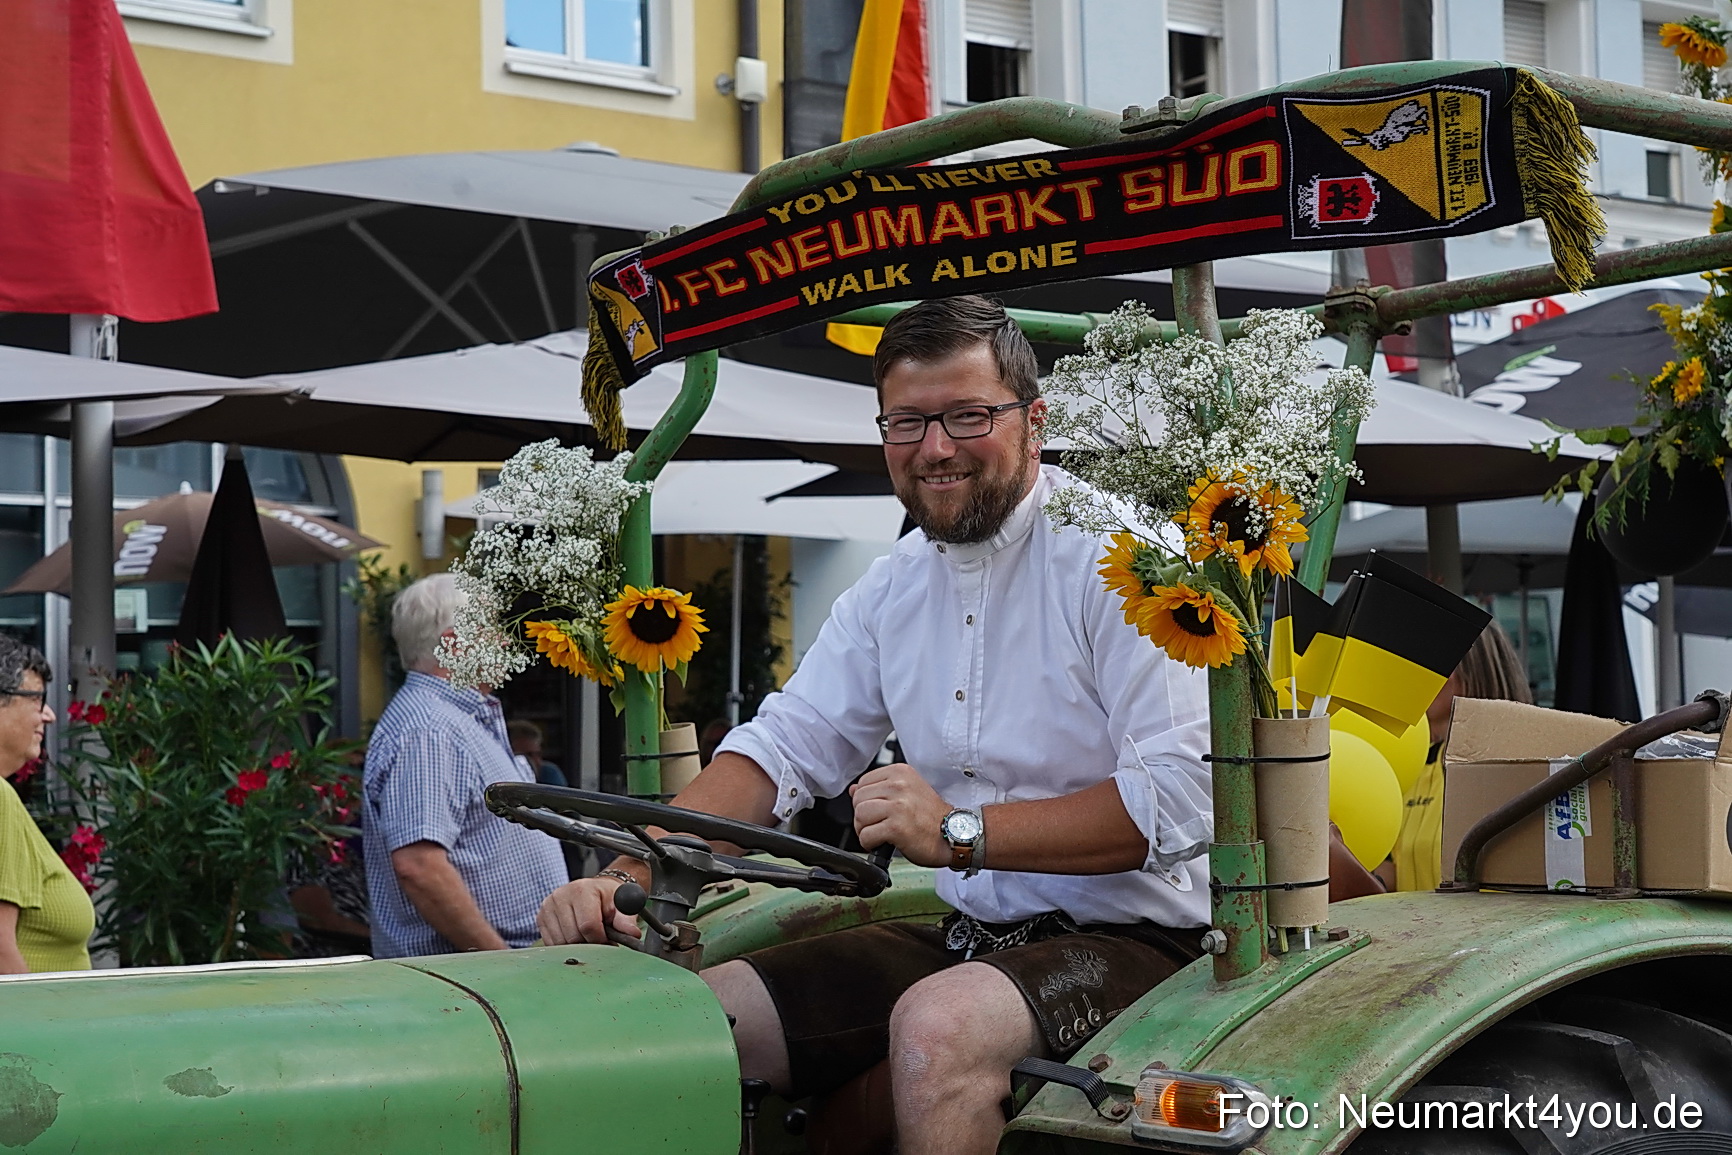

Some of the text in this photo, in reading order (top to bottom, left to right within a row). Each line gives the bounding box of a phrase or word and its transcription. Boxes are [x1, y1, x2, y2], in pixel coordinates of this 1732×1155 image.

[766, 158, 1061, 225] YOU'LL NEVER
[1463, 158, 1480, 186] 1969
[673, 257, 748, 307] FC
[746, 177, 1103, 284] NEUMARKT
[1119, 139, 1282, 214] SÜD
[800, 240, 1078, 306] WALK ALONE
